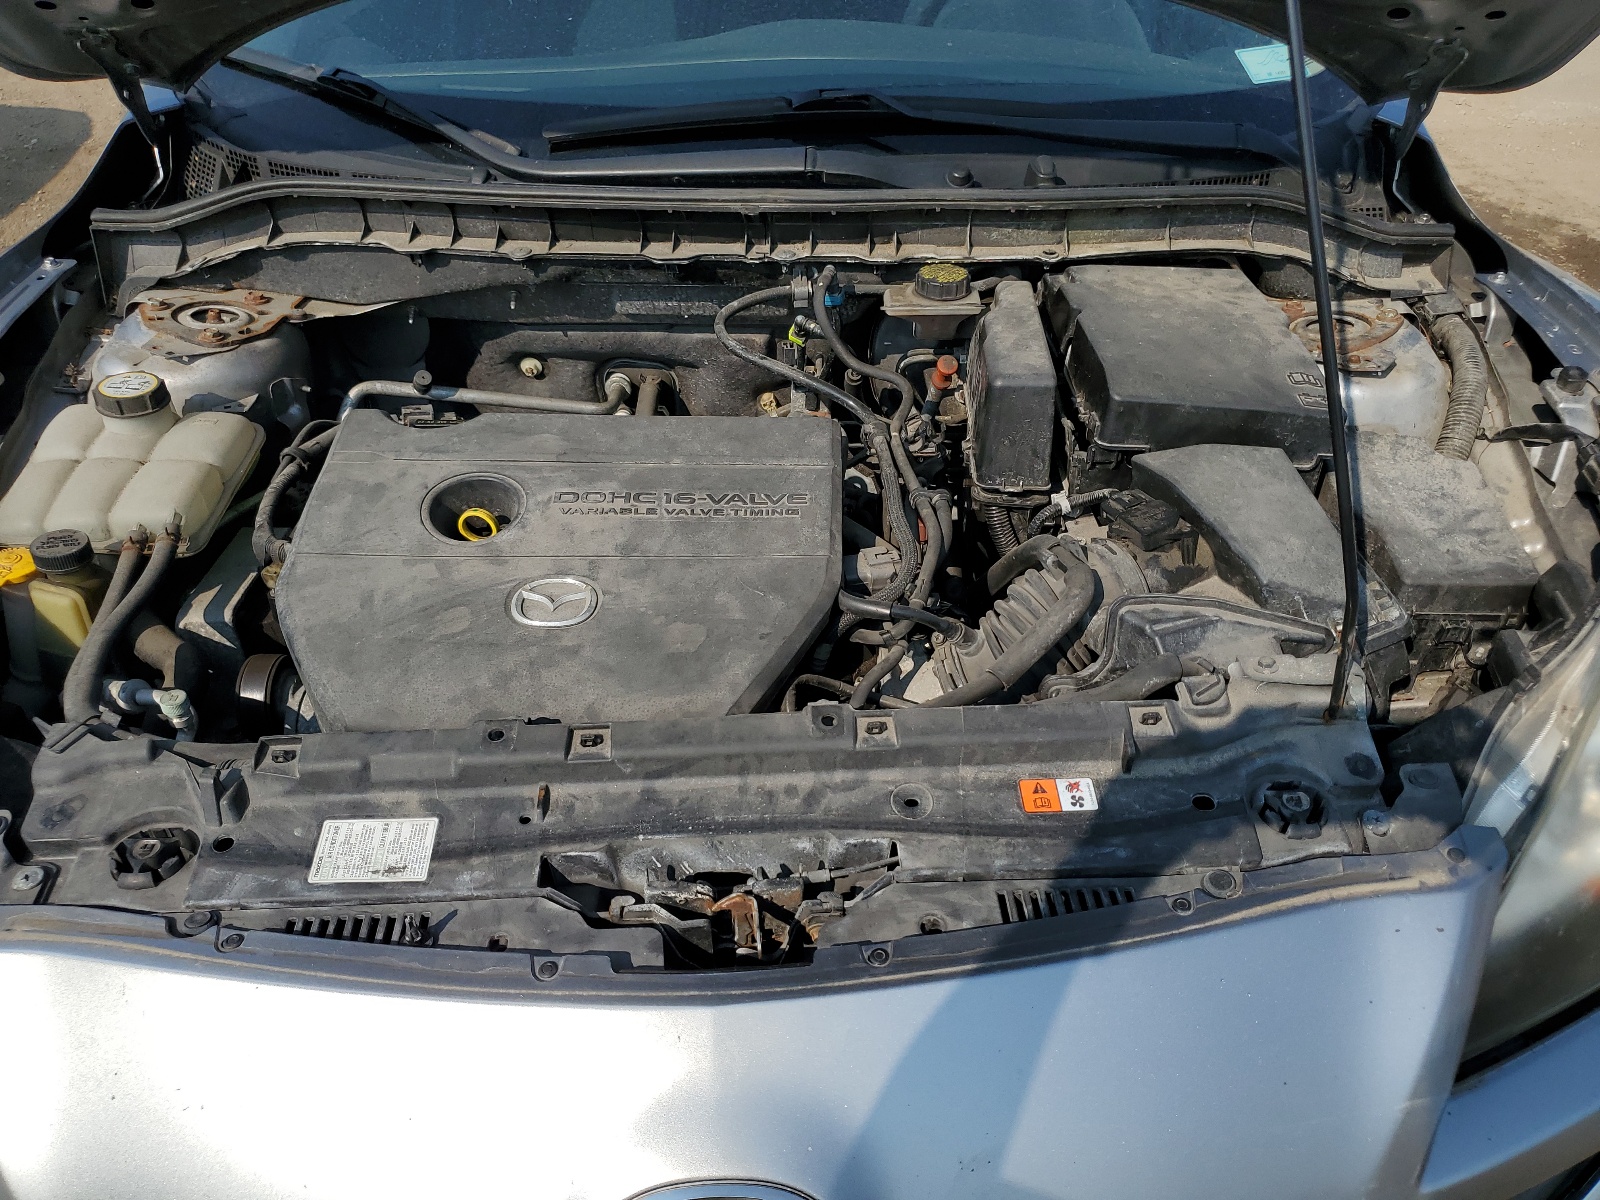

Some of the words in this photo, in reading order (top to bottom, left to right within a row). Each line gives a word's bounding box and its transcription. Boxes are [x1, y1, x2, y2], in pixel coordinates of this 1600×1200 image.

[553, 491, 656, 504] DOHC
[663, 491, 808, 505] 16-VALVE
[560, 507, 659, 515] VARIABLE
[664, 508, 725, 516] VALVE
[730, 508, 800, 516] TIMING
